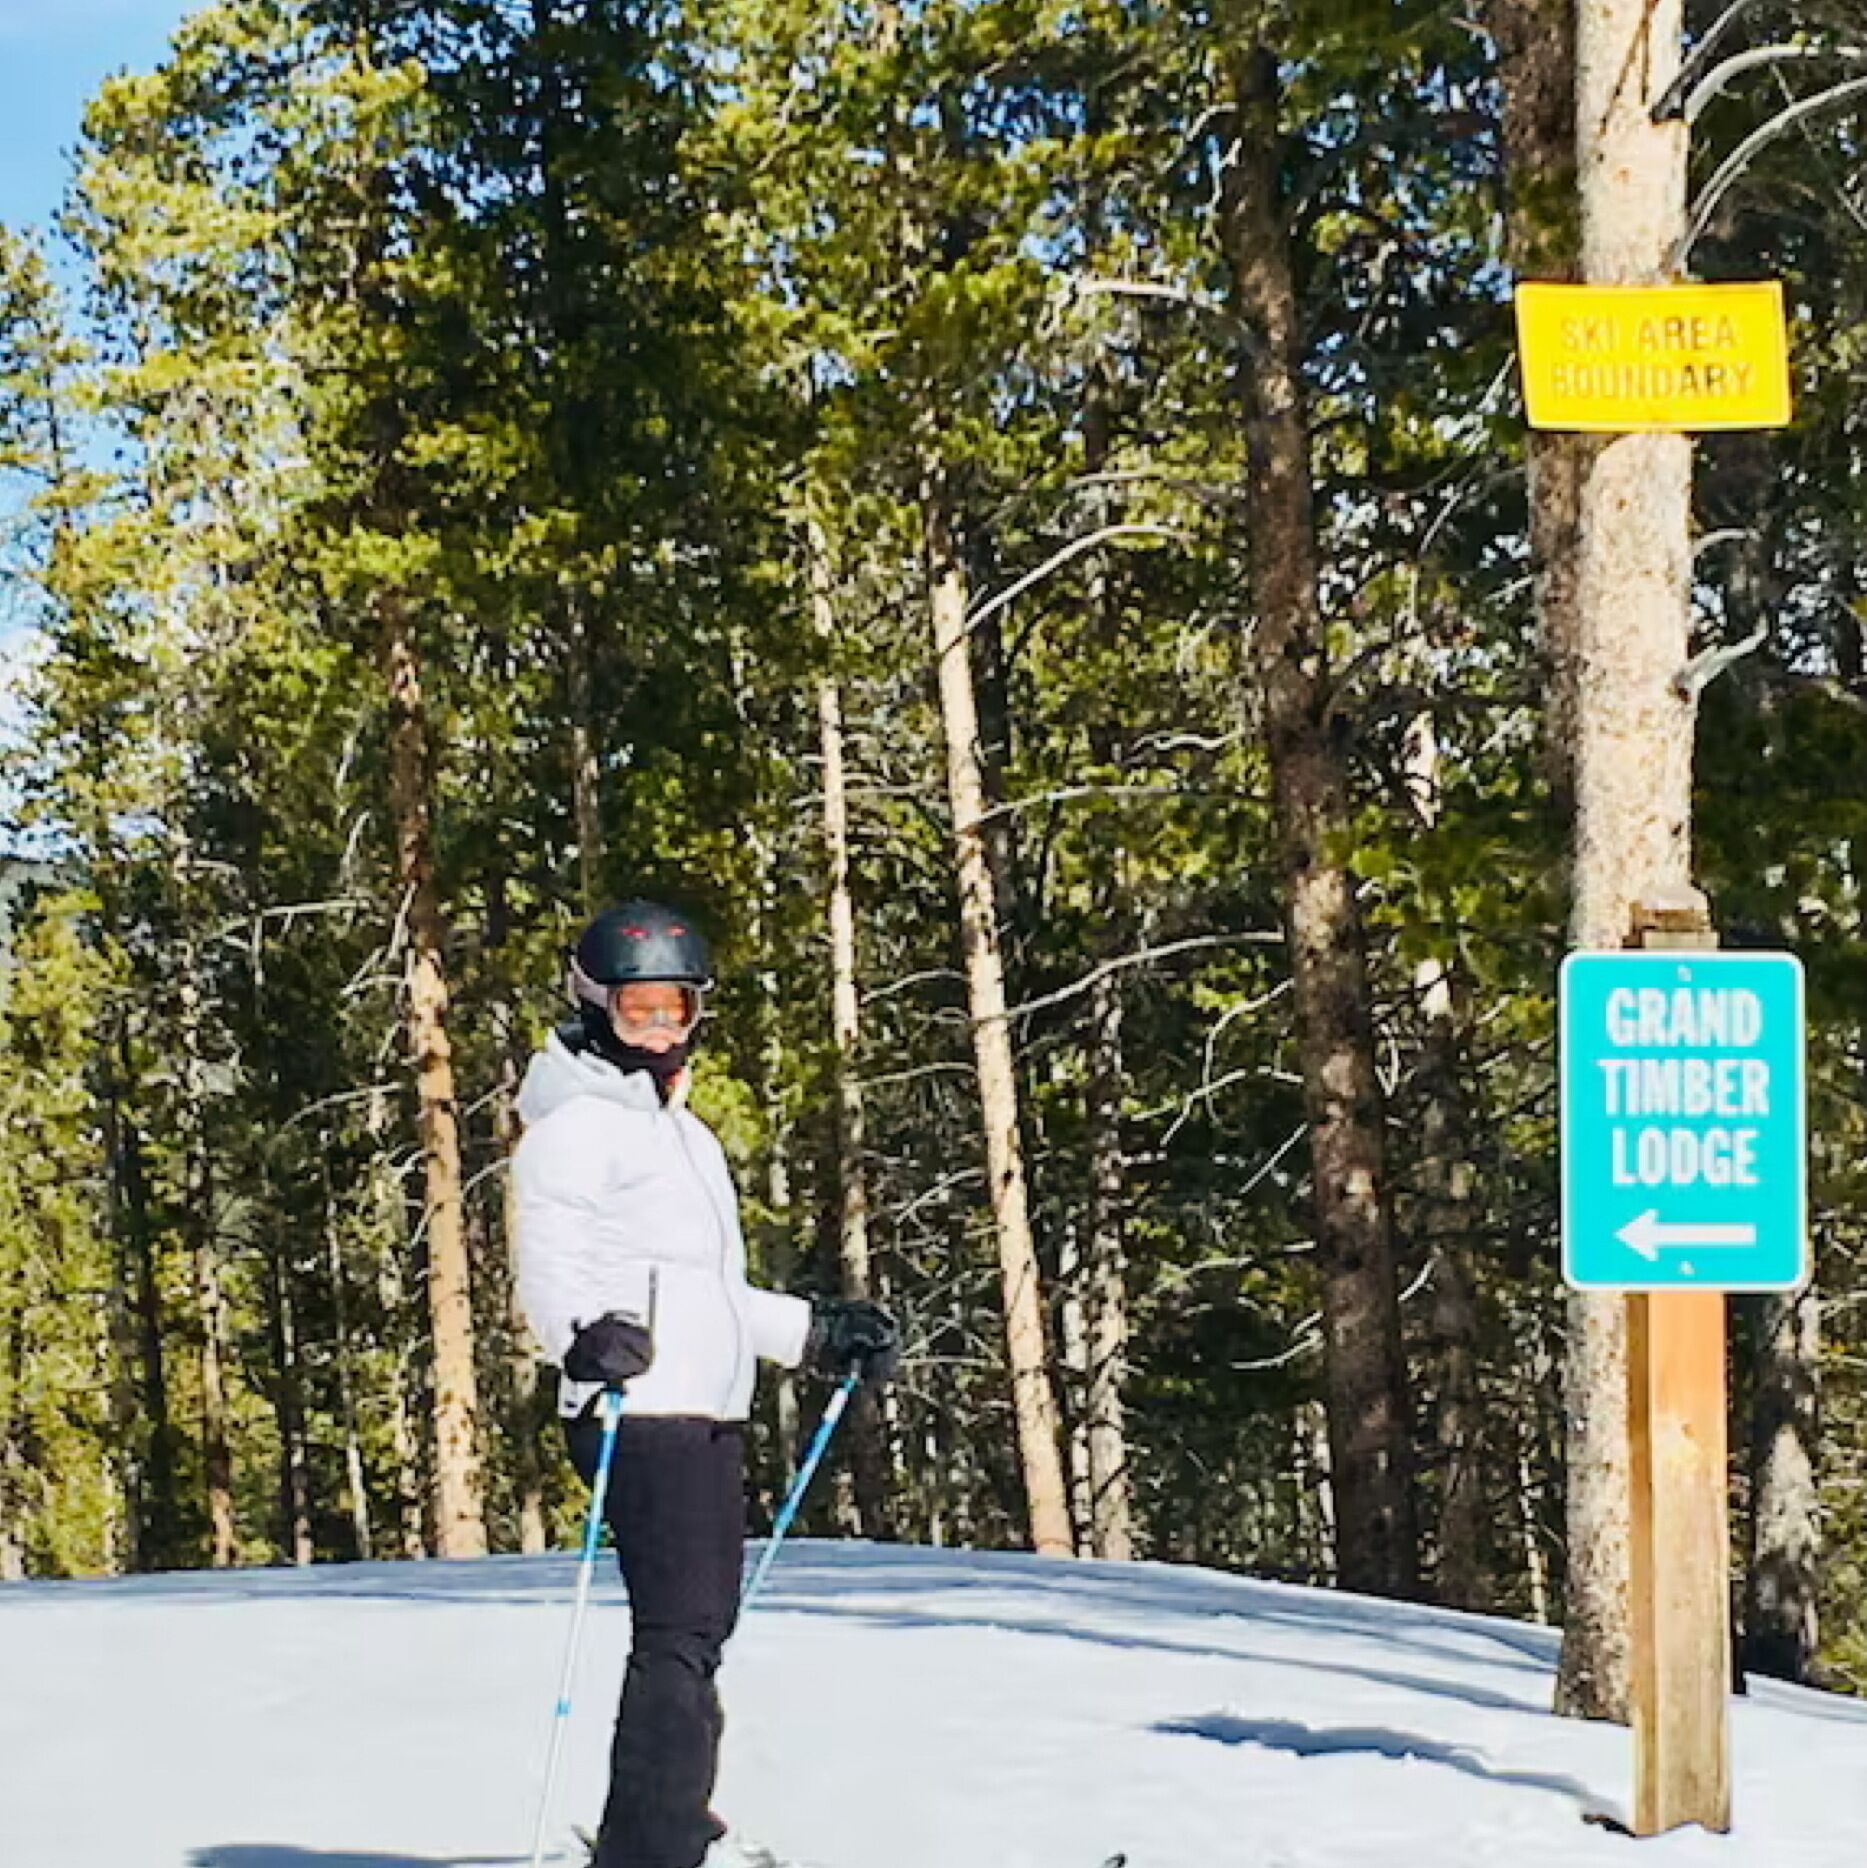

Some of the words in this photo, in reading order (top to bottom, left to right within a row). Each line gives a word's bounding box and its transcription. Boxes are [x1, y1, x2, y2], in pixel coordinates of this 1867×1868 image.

[1560, 315, 1616, 351] SKI
[1638, 314, 1737, 350] AREA
[1551, 360, 1750, 399] BOUNDARY
[1606, 987, 1763, 1047] GRAND
[1596, 1059, 1770, 1117] TIMBER
[1612, 1128, 1760, 1187] LODGE
